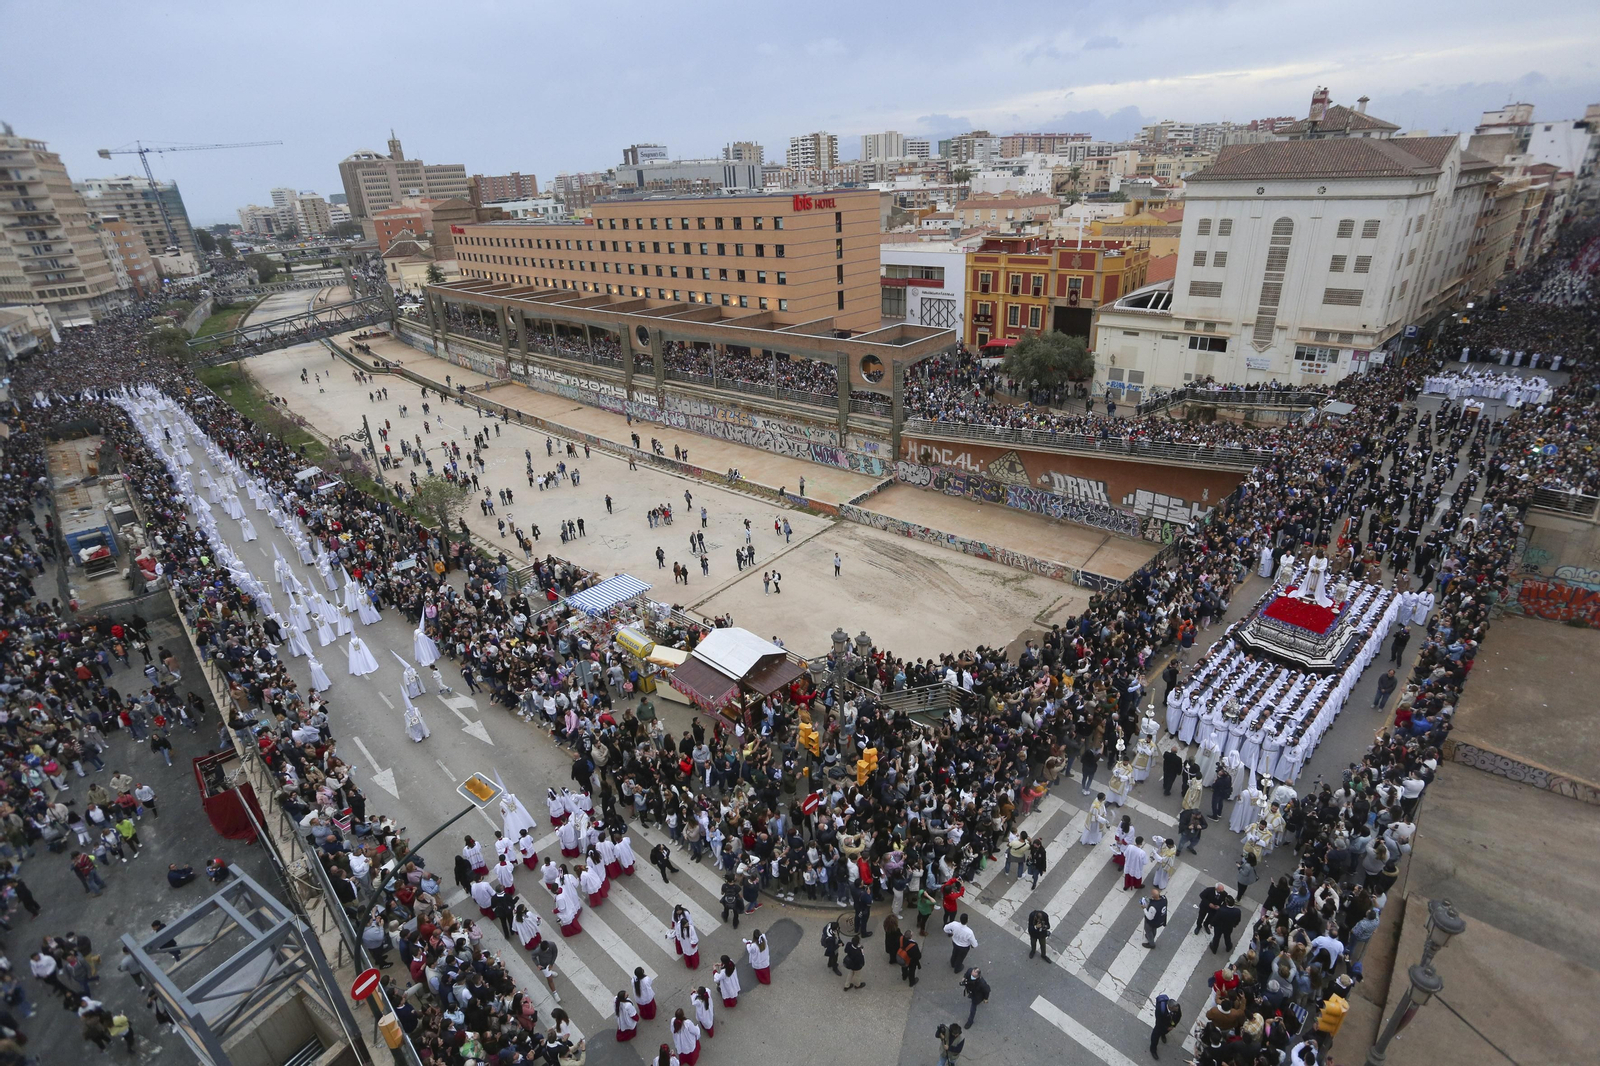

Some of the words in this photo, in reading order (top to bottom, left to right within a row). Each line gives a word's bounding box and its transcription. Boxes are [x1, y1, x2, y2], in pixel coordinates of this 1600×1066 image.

[793, 194, 813, 212] ibis
[815, 198, 837, 209] HOTEL
[1404, 325, 1417, 336] P
